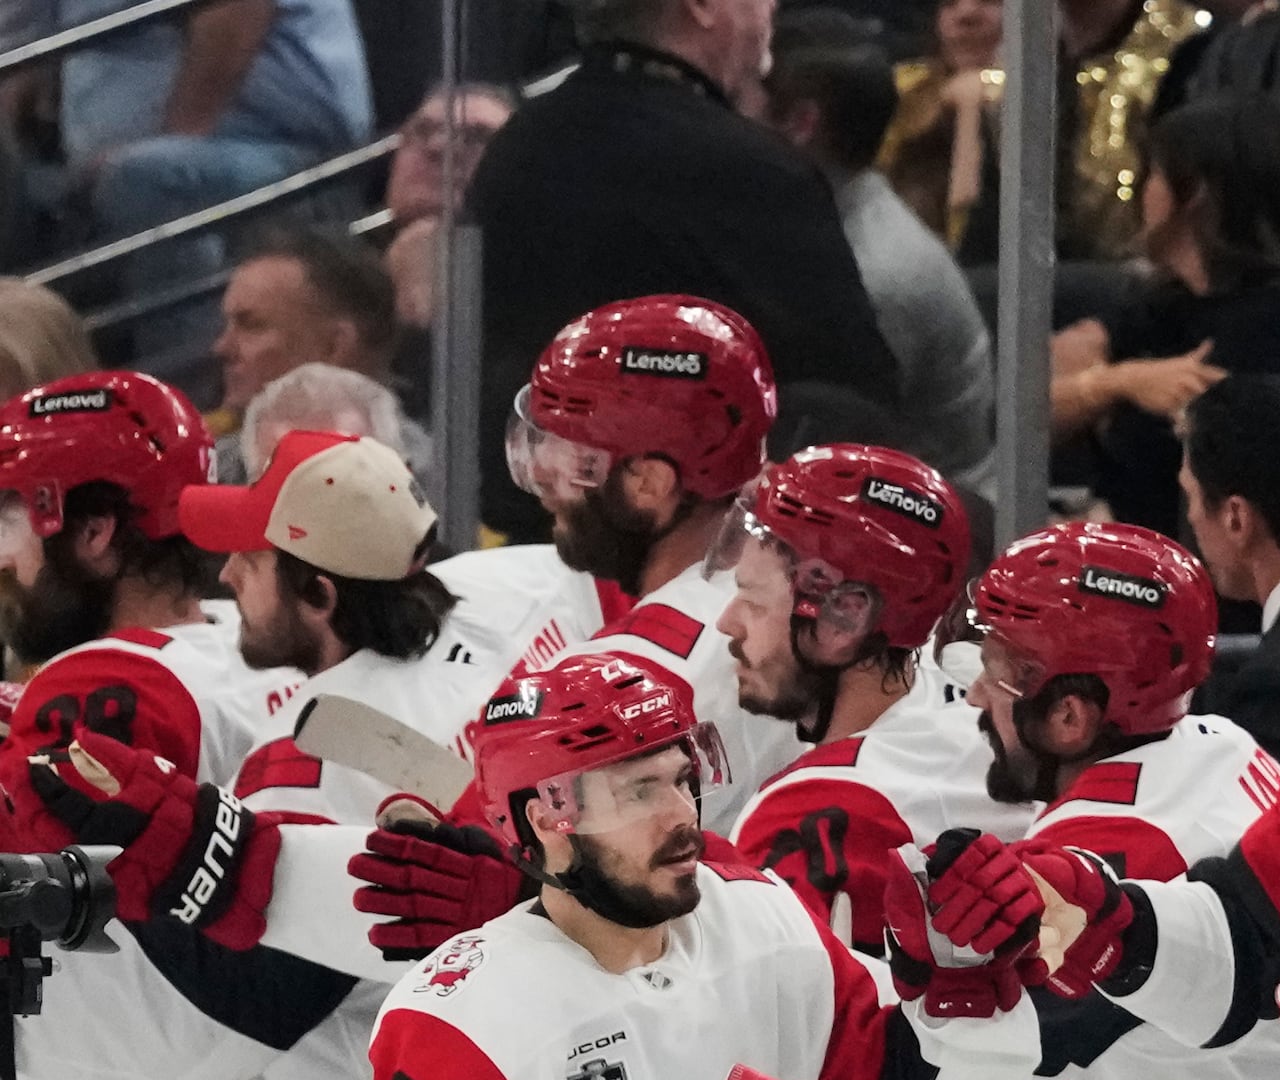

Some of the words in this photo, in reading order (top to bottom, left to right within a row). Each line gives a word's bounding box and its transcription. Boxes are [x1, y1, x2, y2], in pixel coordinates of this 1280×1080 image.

[867, 479, 937, 523] Lenovo
[1084, 569, 1160, 604] Lenovo
[486, 699, 537, 721] Lenovo
[623, 694, 670, 720] CCM
[567, 1030, 628, 1060] UCOR
